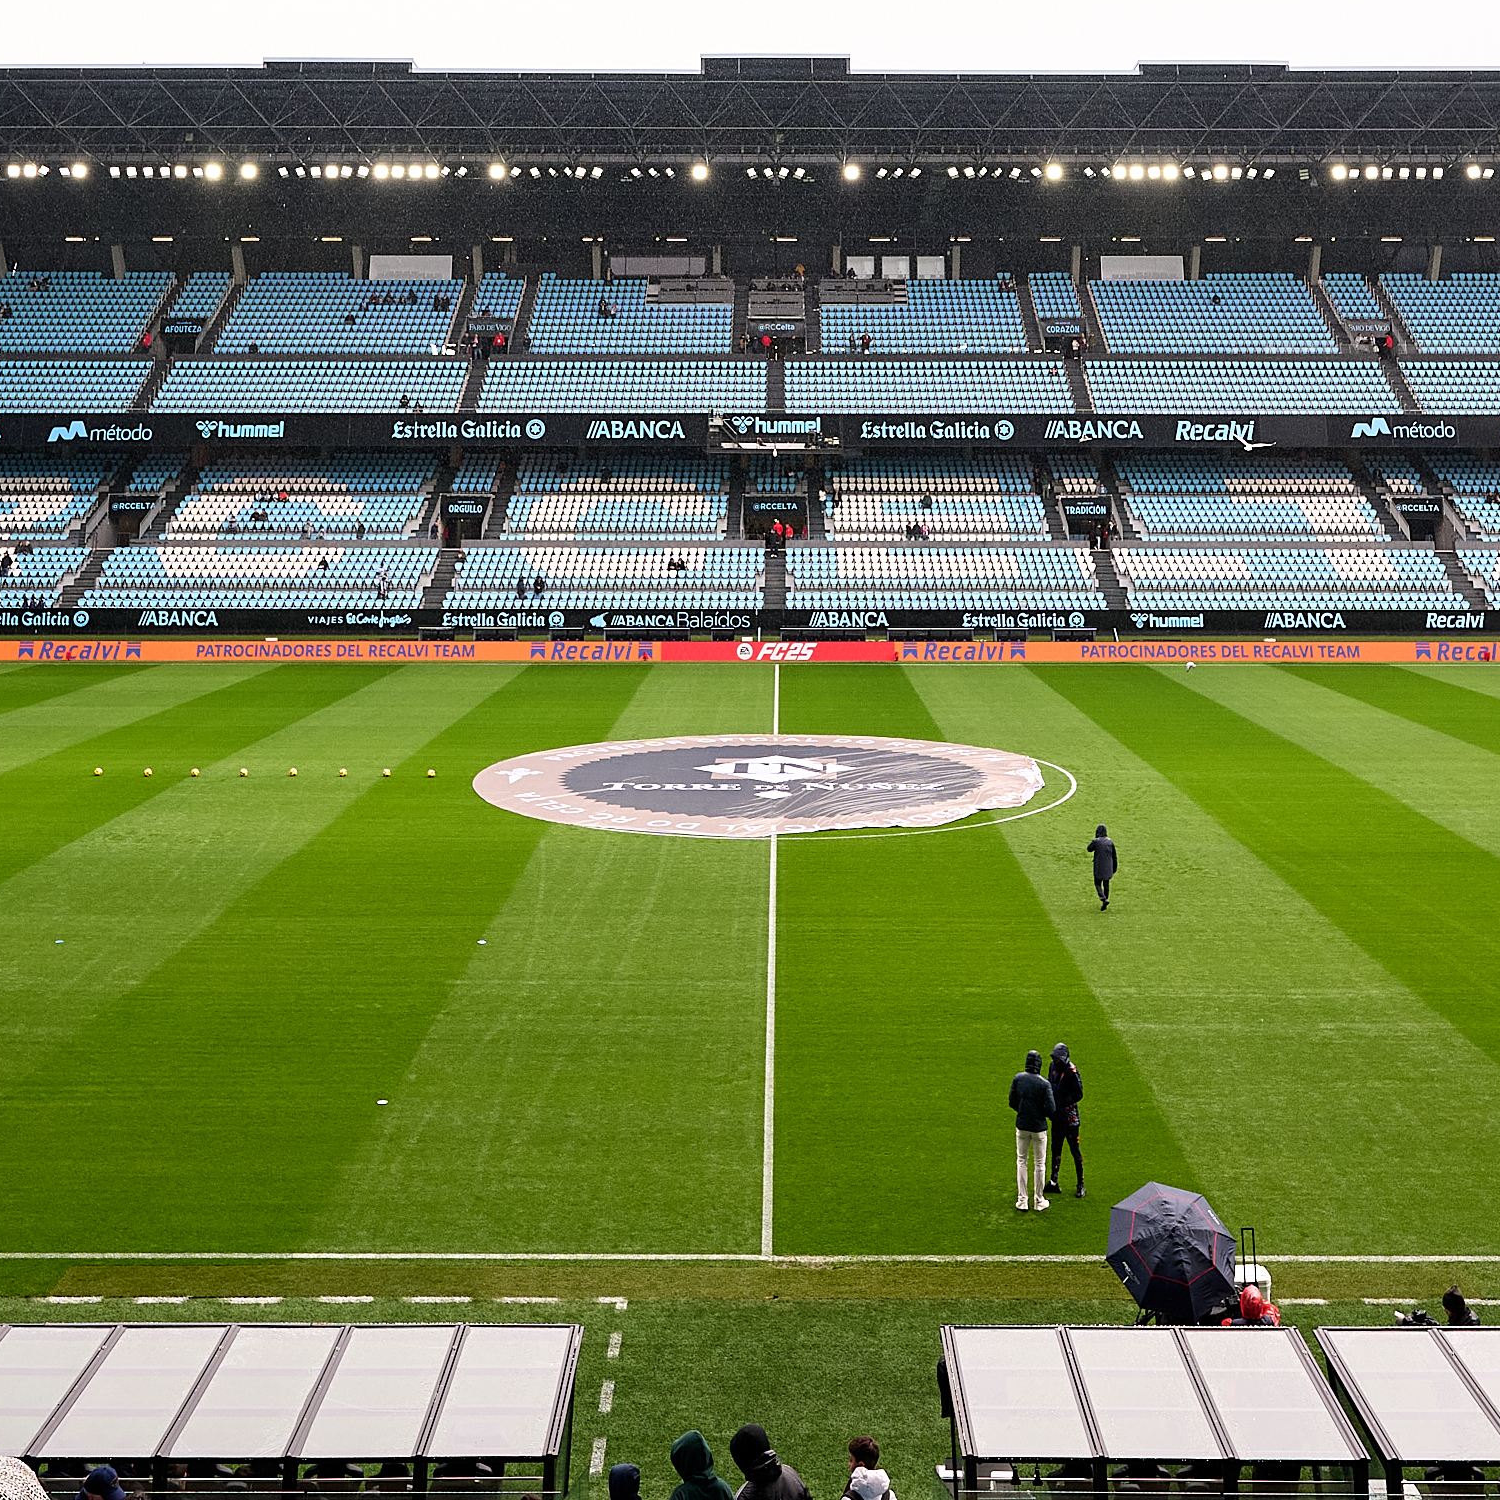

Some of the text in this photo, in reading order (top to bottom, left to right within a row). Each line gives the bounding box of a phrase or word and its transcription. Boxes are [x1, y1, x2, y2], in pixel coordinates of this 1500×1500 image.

[164, 325, 202, 334] AFOUTEZA
[469, 323, 486, 331] FARO
[495, 323, 512, 331] VIGO
[757, 323, 795, 332] @RCCelta
[89, 423, 153, 442] método
[217, 420, 285, 439] hummel
[391, 420, 522, 439] Estrella Galicia
[754, 416, 822, 434] hummel
[860, 421, 990, 440] Estrella Galicia
[1175, 419, 1255, 442] Recalvi
[1392, 421, 1456, 440] método
[448, 504, 483, 514] ORGULLO
[752, 502, 798, 512] @RCCELTA
[1064, 504, 1107, 515] TRADICIÓN
[21, 611, 71, 627] Galicia
[307, 616, 344, 626] VIAJES
[442, 612, 545, 628] Estrella Galicia
[676, 610, 751, 628] Balaídos
[961, 612, 1067, 628] Estrella Galicia
[1148, 612, 1204, 628] hummel
[1425, 612, 1485, 629] Recalvi
[39, 640, 122, 661] Recalvi
[196, 643, 475, 659] PATROCINADORES DEL RECALVI TEAM
[551, 640, 633, 661] Recalvi
[923, 640, 1004, 661] Recalvi
[1081, 644, 1361, 660] PATROCINADORES DEL RECALVI TEAM
[602, 781, 742, 791] TORRE
[753, 782, 791, 791] DE
[513, 791, 586, 814] CELTA
